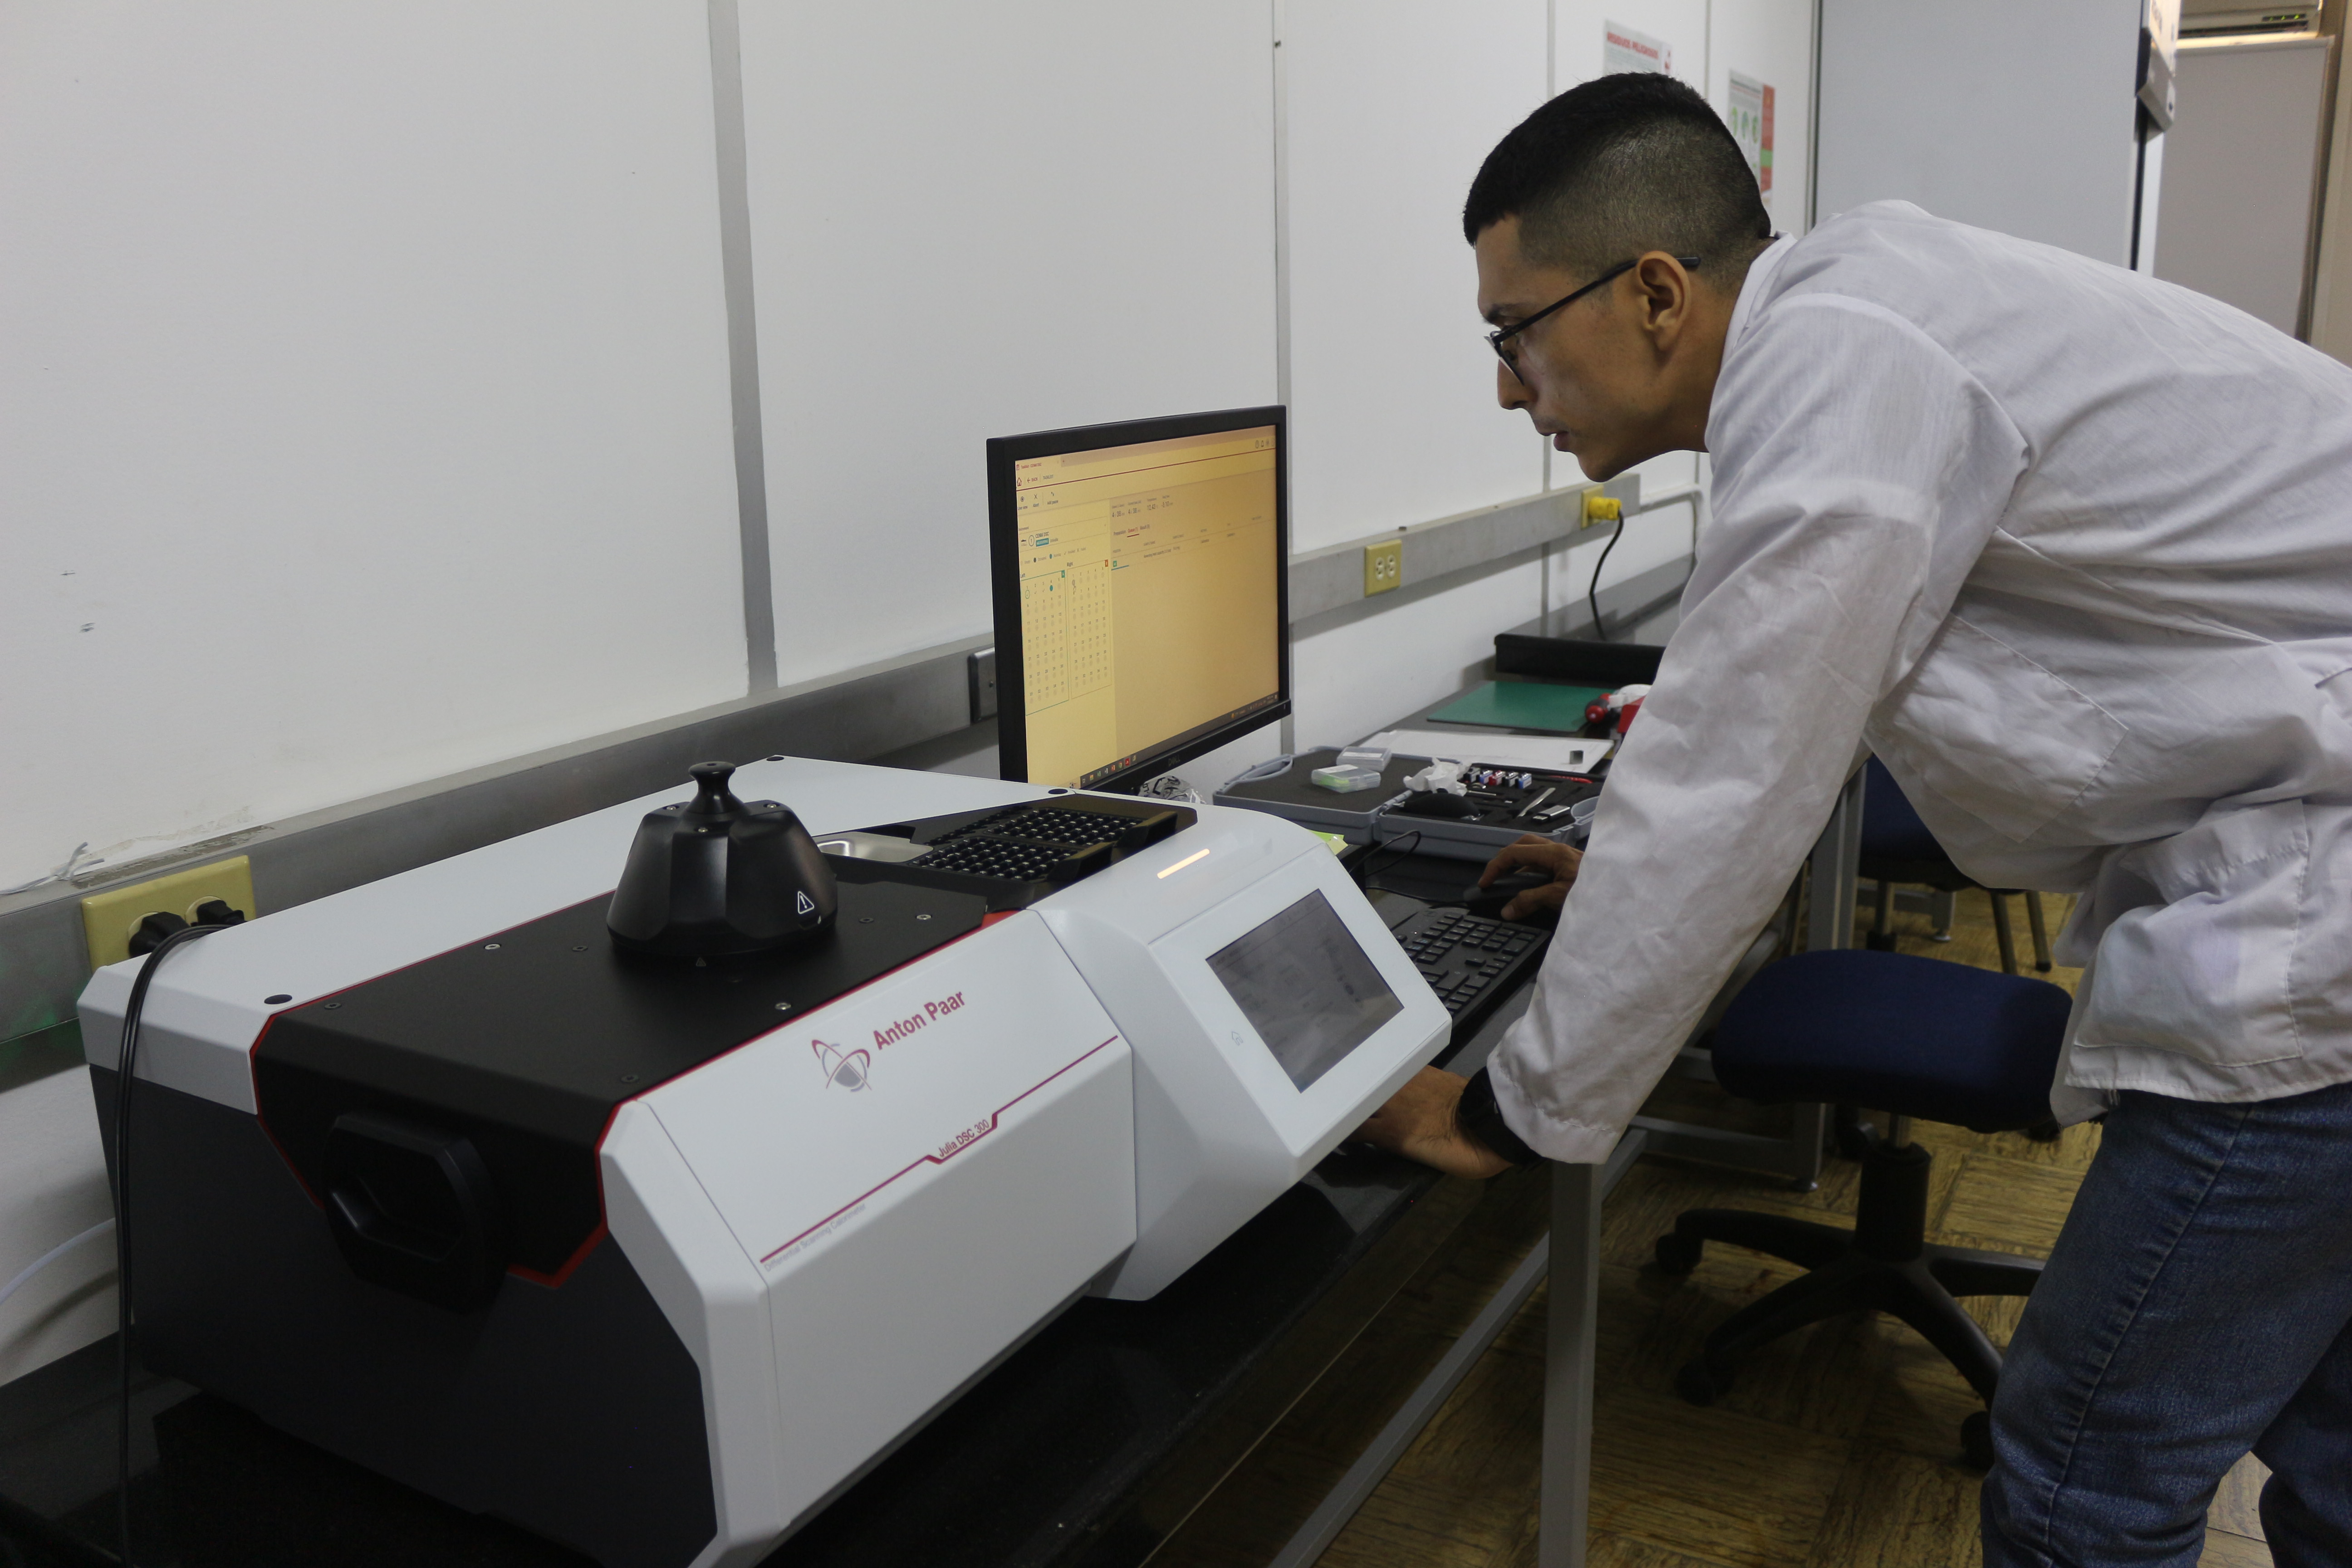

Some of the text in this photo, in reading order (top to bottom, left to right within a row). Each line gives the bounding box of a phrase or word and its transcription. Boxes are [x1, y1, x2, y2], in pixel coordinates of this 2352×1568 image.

[873, 991, 965, 1050] Anton Paar
[938, 1119, 989, 1157] Julia DSC 300
[764, 1203, 866, 1272] Differential Scanning Calorimeter
